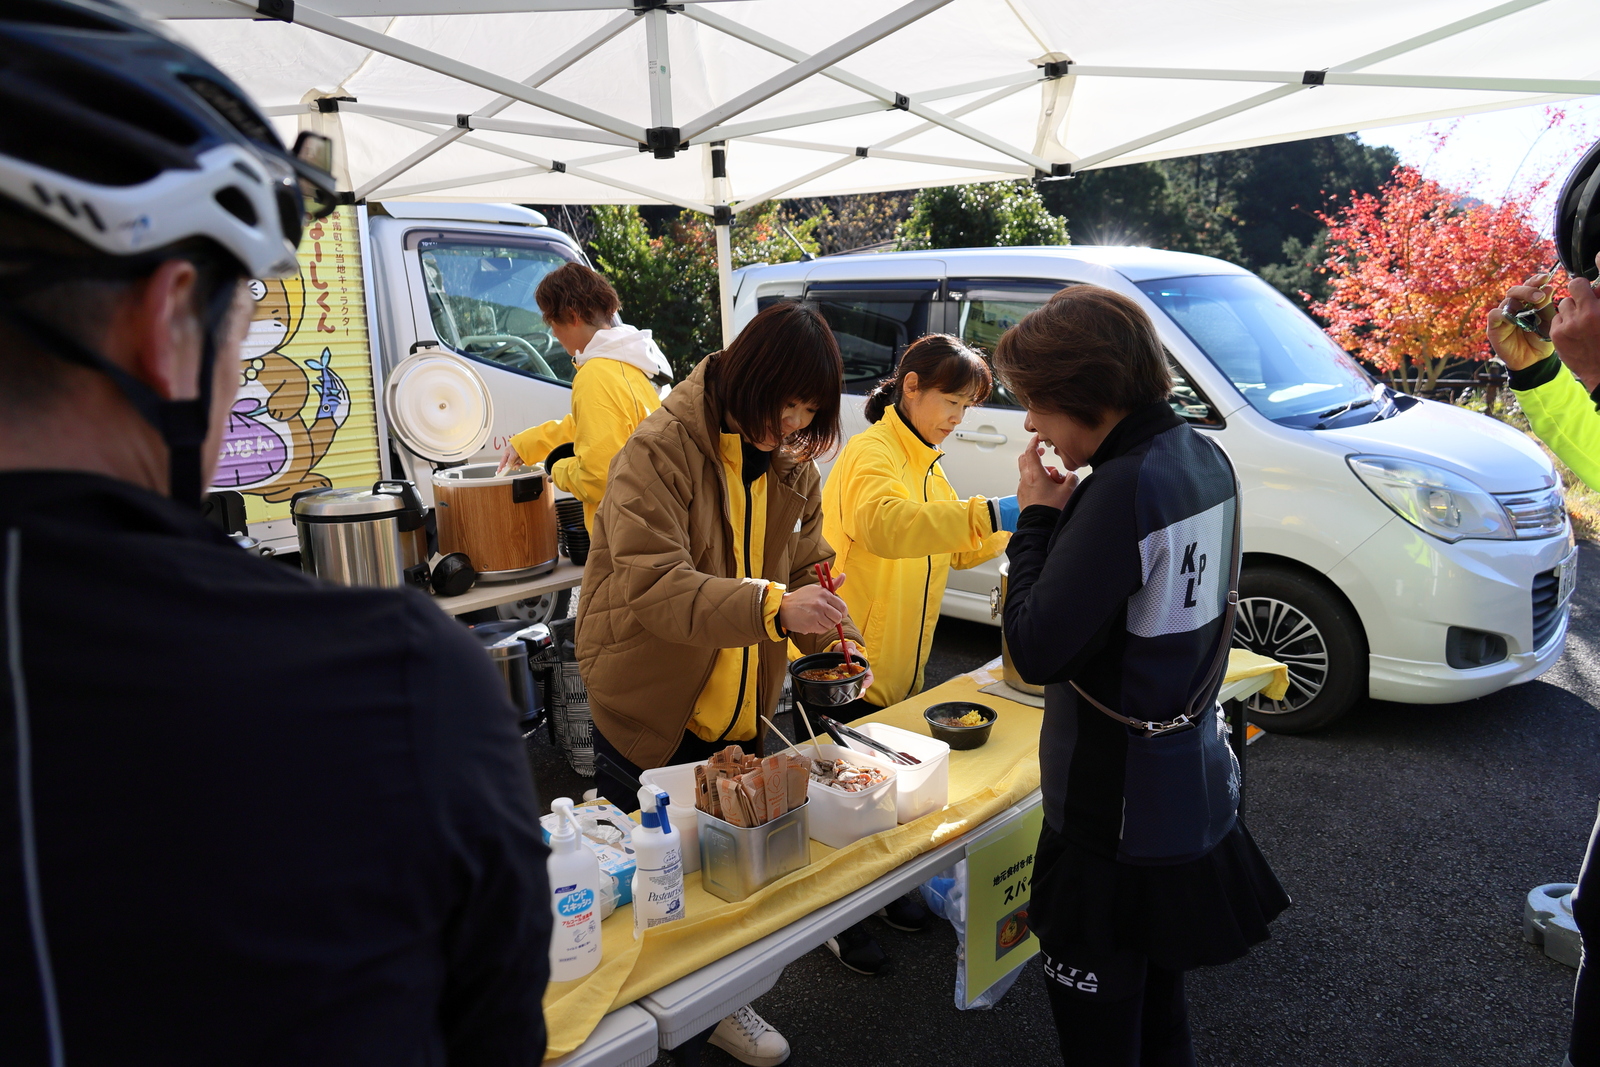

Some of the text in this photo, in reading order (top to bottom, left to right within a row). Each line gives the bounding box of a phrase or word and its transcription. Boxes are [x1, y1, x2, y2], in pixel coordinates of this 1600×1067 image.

[332, 211, 350, 336] 愛南町ご当地キャラクター
[993, 854, 1036, 887] 地元食材を使
[562, 898, 592, 914] スキッシュ
[567, 889, 587, 904] ハンド
